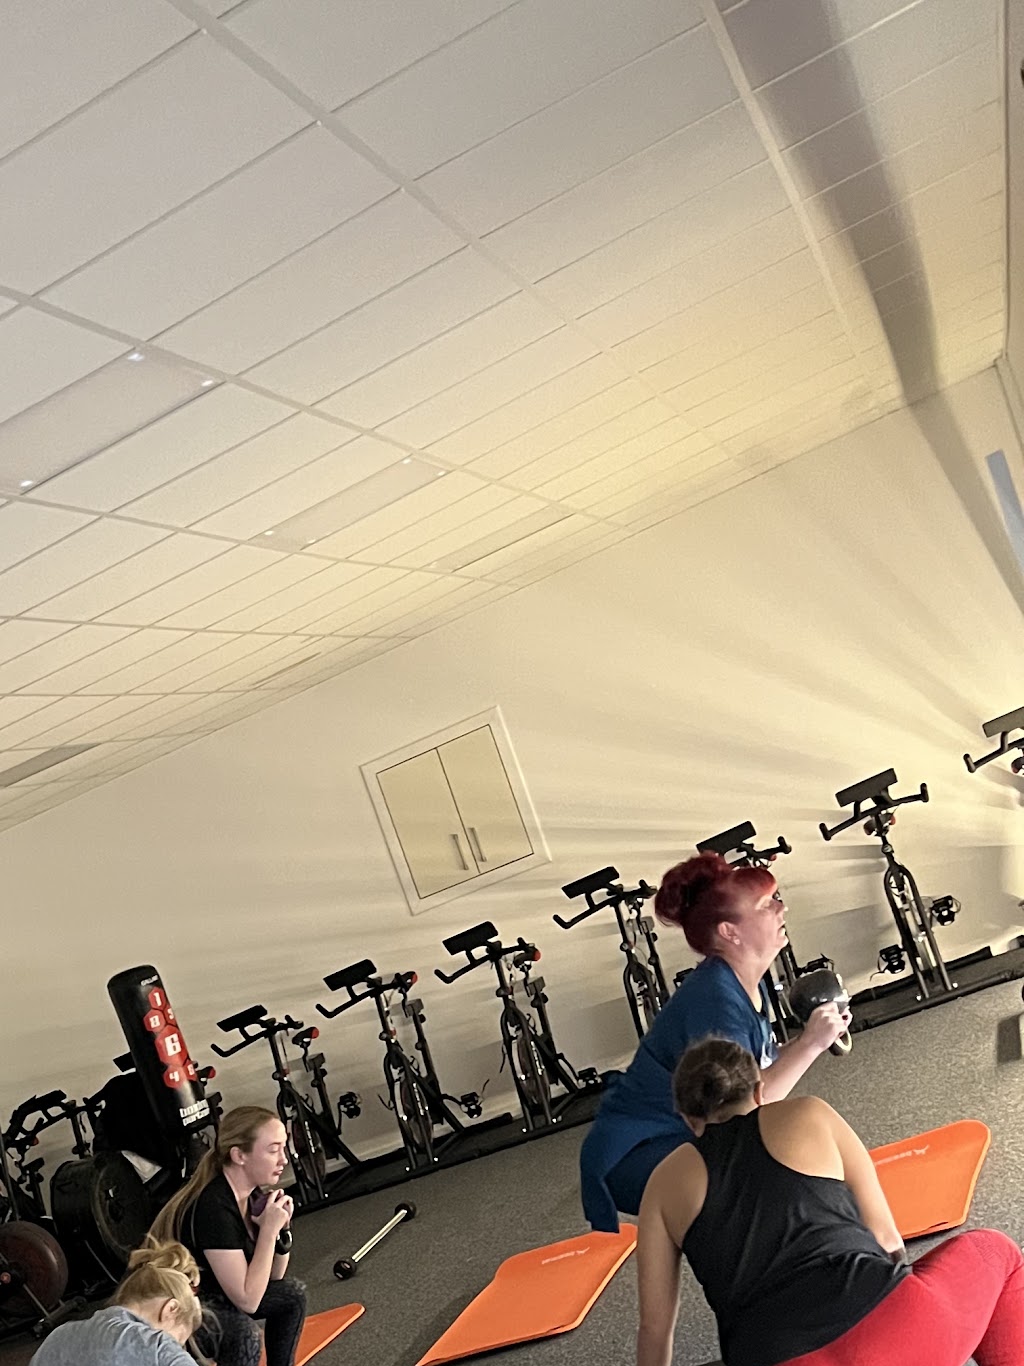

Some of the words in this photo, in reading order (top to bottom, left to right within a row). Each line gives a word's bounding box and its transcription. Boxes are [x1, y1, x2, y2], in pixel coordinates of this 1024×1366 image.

[154, 992, 162, 1007] 1
[164, 1033, 182, 1057] 6
[169, 1071, 180, 1082] 4
